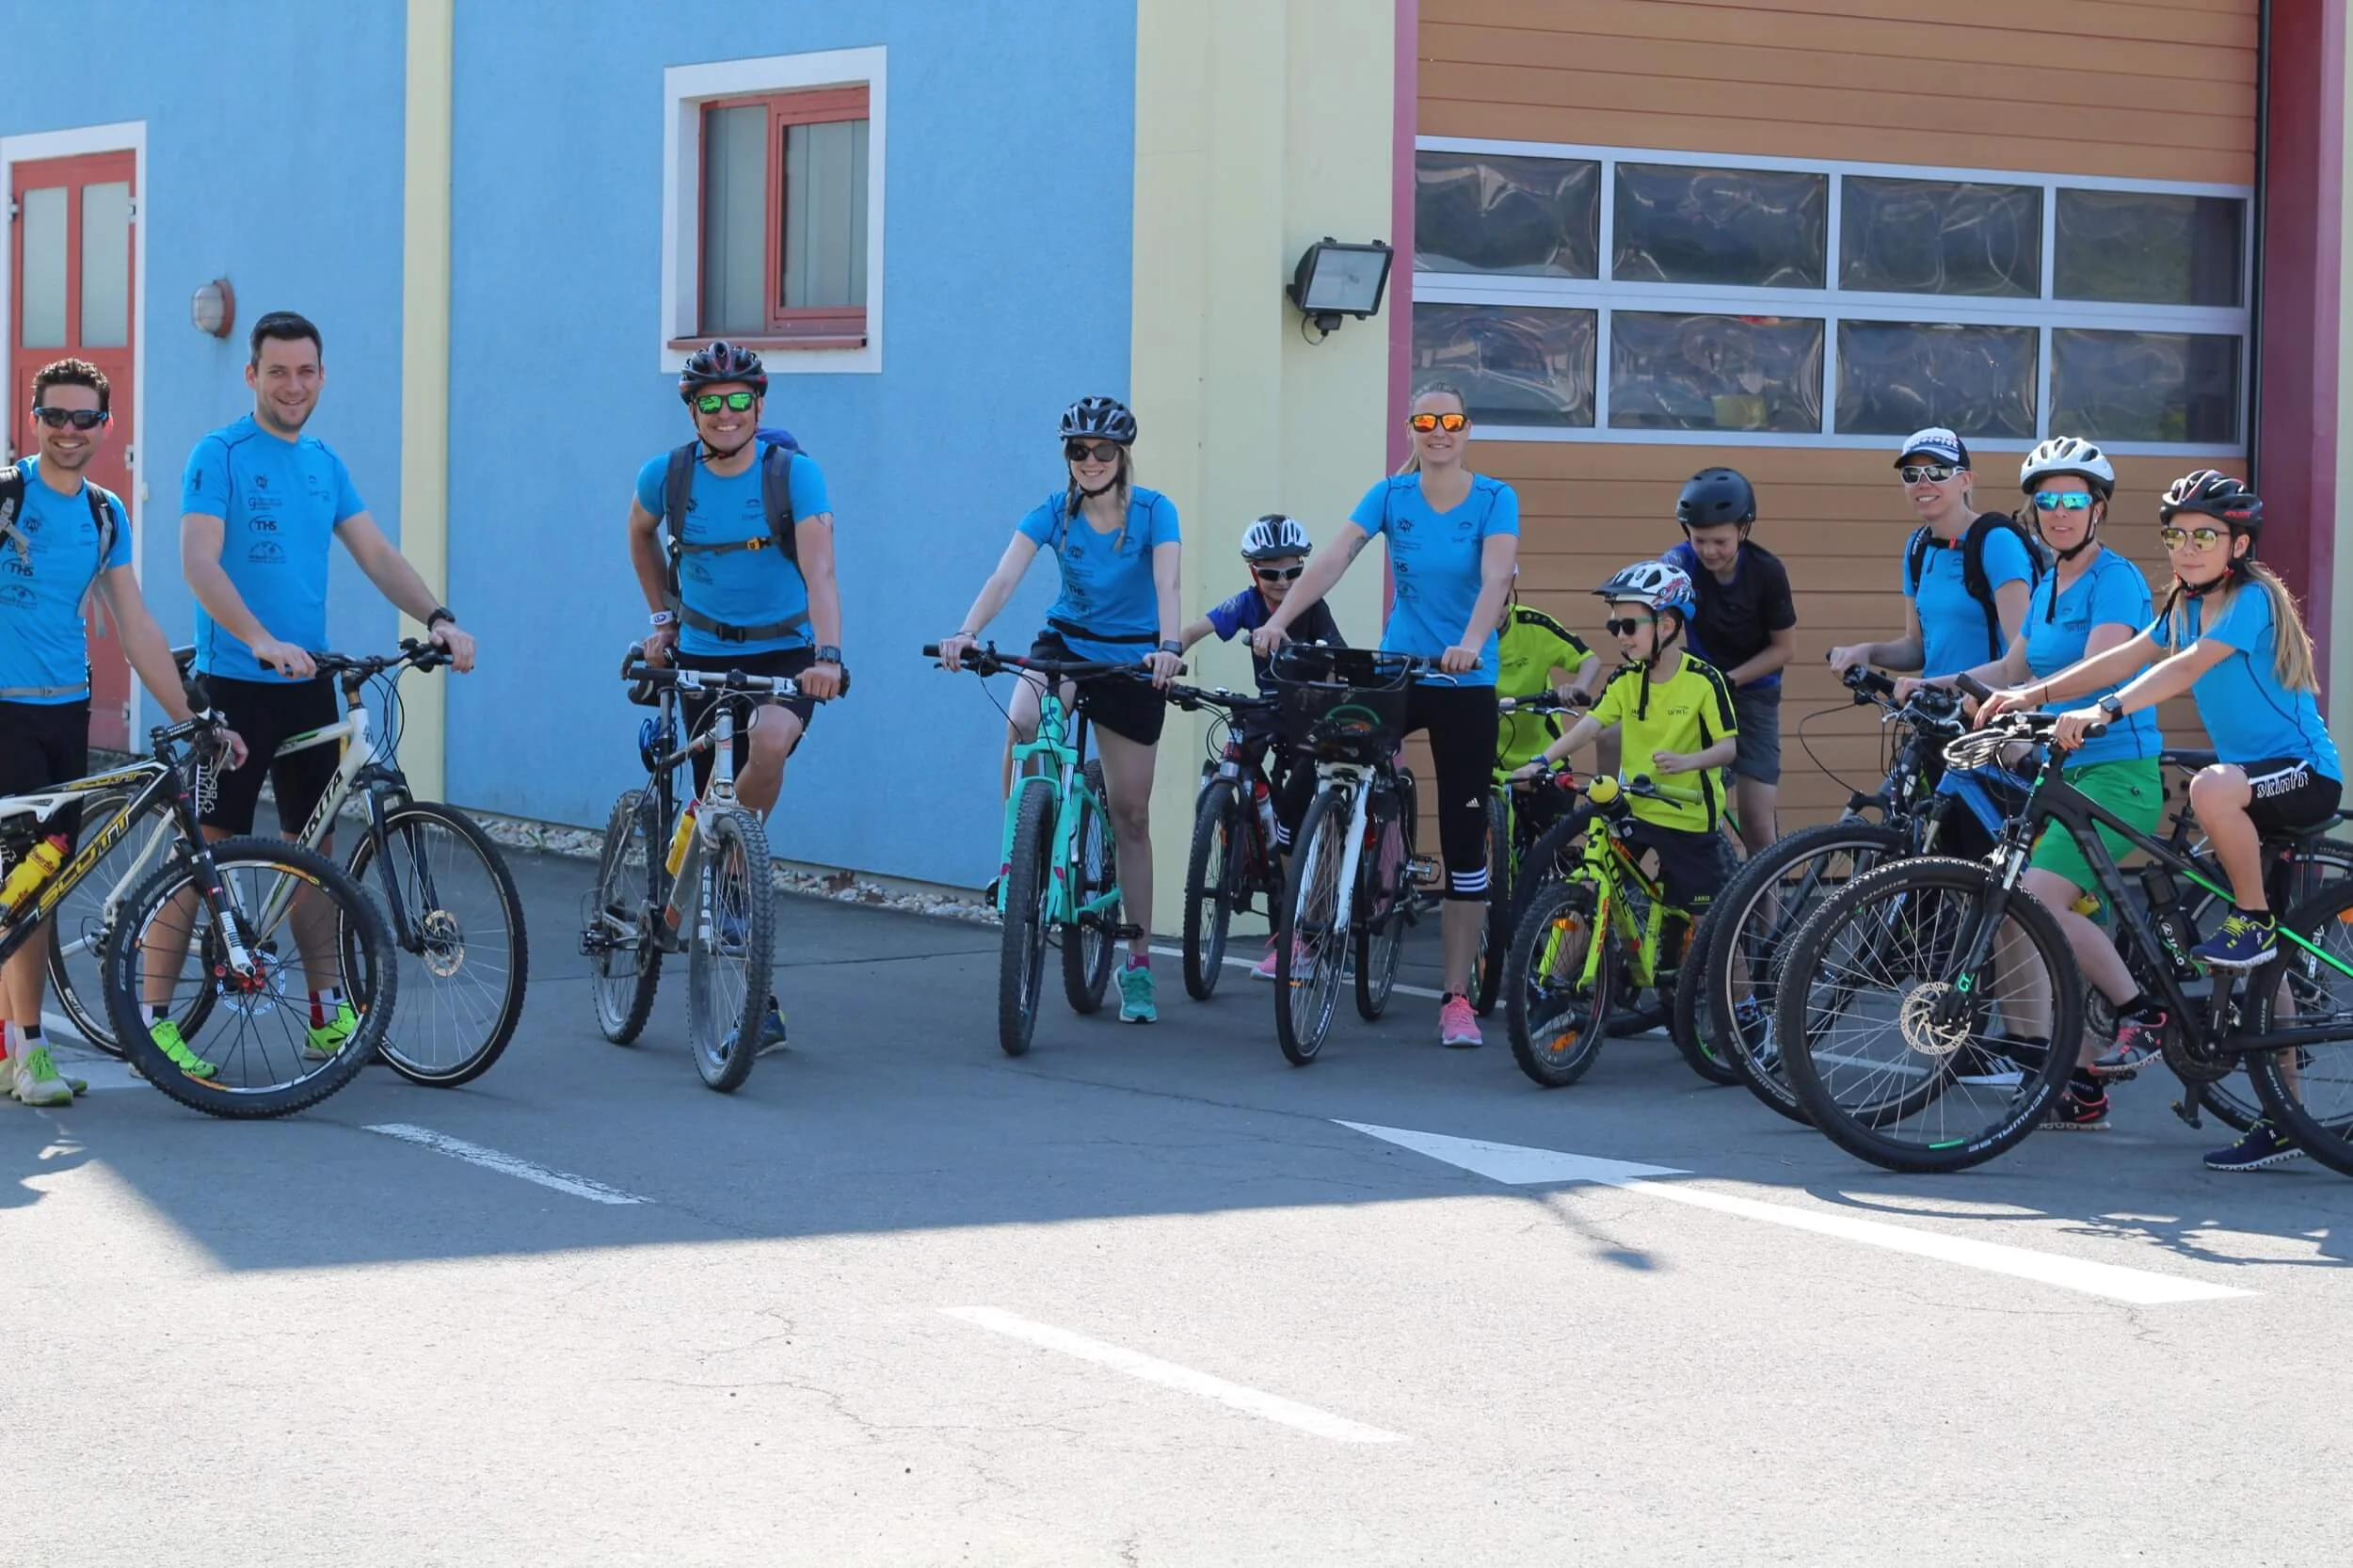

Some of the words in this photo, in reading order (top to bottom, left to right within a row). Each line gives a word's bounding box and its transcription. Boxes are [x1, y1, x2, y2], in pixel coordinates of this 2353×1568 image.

[254, 520, 278, 532] THS
[39, 807, 130, 913] SCOTT
[1605, 848, 1631, 918] CUBE
[1968, 1083, 2051, 1154] SCHWALBE
